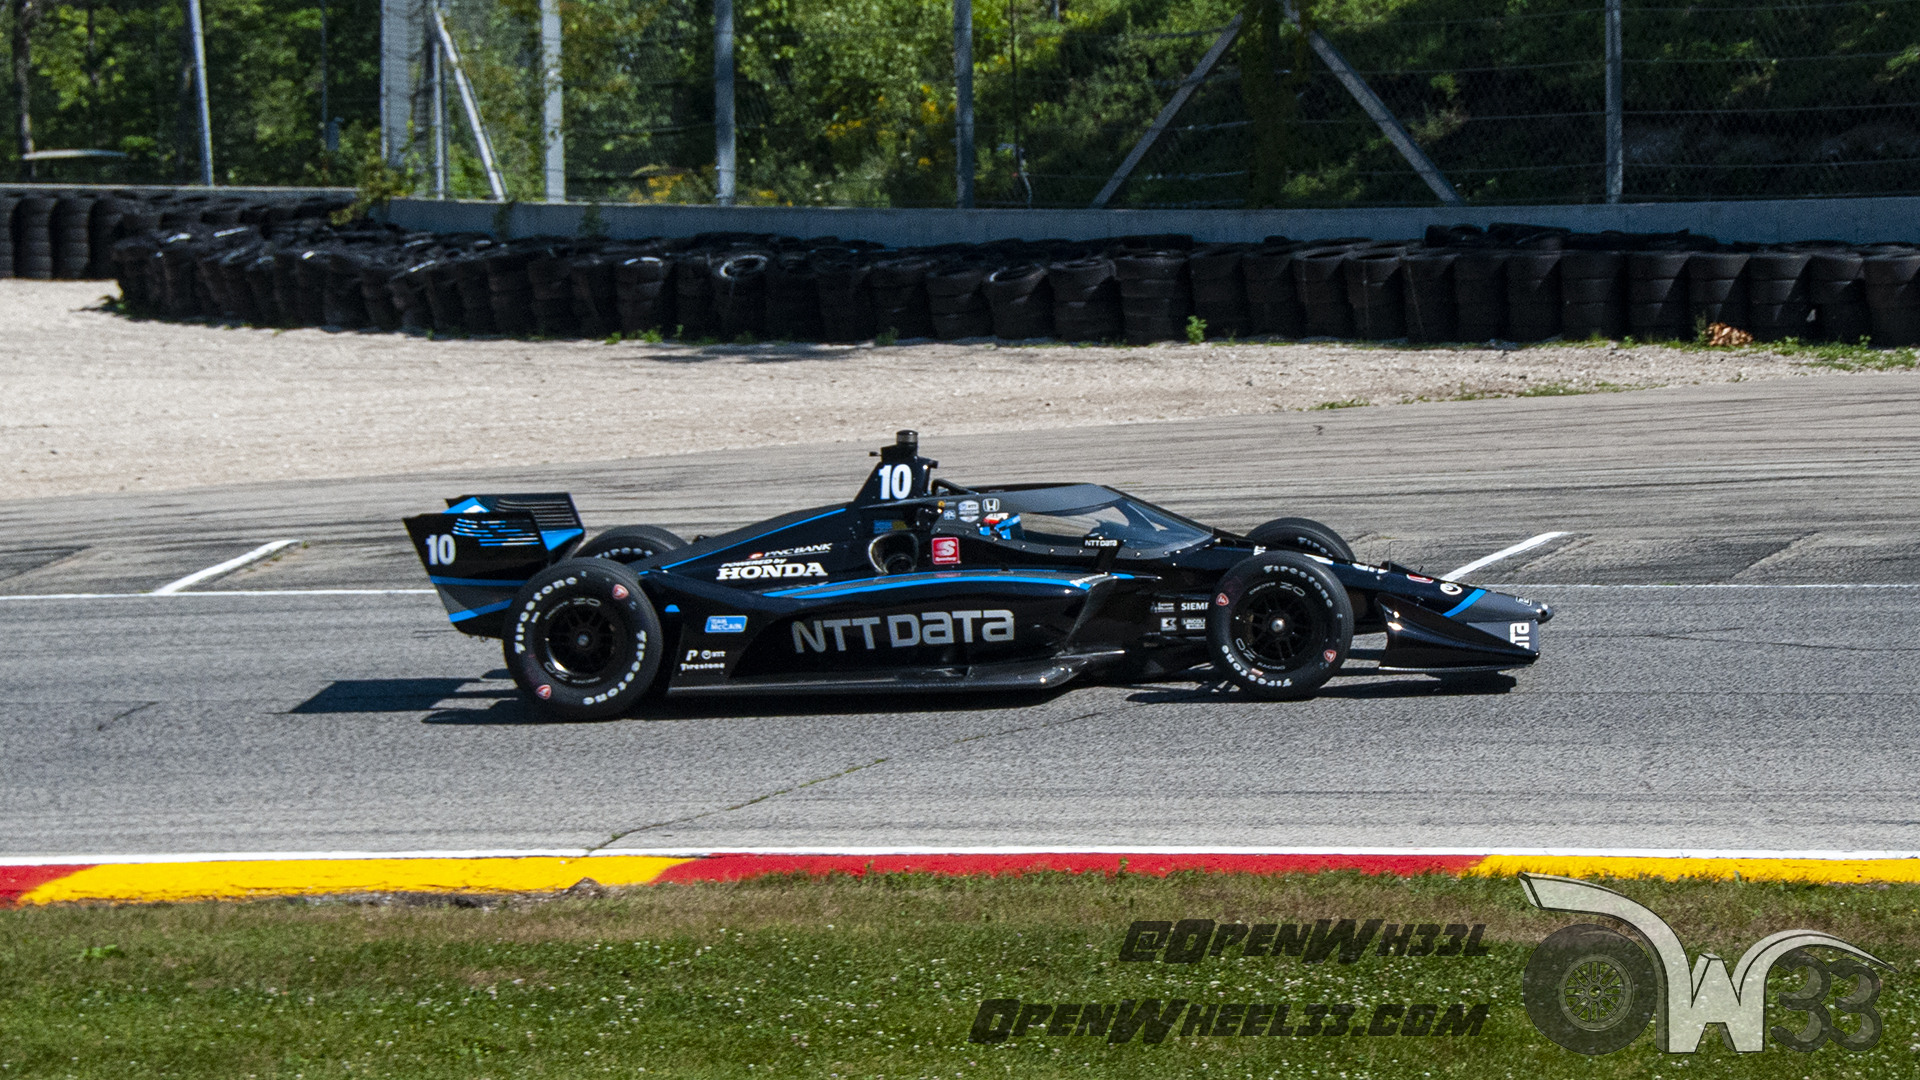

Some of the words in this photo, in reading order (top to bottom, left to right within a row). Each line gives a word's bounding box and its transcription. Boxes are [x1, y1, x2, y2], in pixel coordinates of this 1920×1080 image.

[878, 464, 913, 500] 10
[425, 534, 457, 566] 10
[764, 548, 794, 557] PNC
[794, 542, 833, 554] BANK
[1084, 539, 1100, 547] NTT
[716, 562, 829, 580] HONDA
[720, 558, 773, 568] POWERED
[1263, 564, 1333, 608] Firestone
[513, 576, 578, 654] Firestone
[1180, 601, 1209, 611] SIEM
[790, 616, 880, 653] NTT
[583, 630, 648, 705] Firestone
[680, 662, 725, 671] Firestone
[1221, 644, 1293, 688] Firestone
